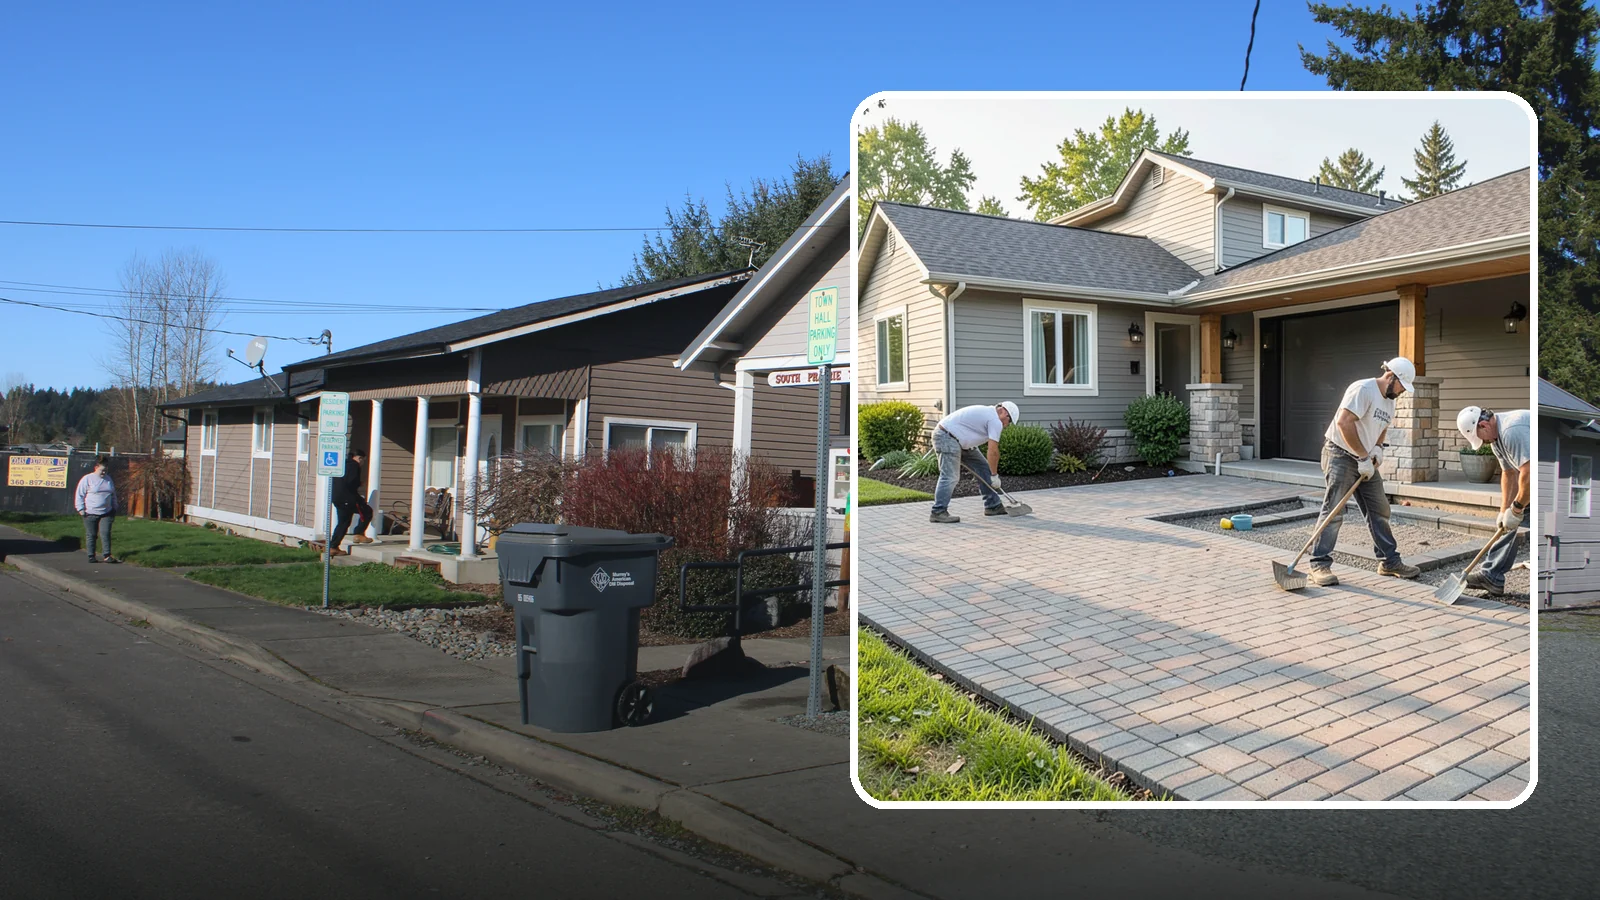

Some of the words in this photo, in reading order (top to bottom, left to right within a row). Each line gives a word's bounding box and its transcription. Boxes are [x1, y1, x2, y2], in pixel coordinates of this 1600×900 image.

[815, 295, 833, 307] TOWN
[814, 311, 831, 324] HALL
[810, 327, 836, 341] PARKING
[813, 344, 831, 357] ONLY
[775, 373, 801, 384] SOUTH
